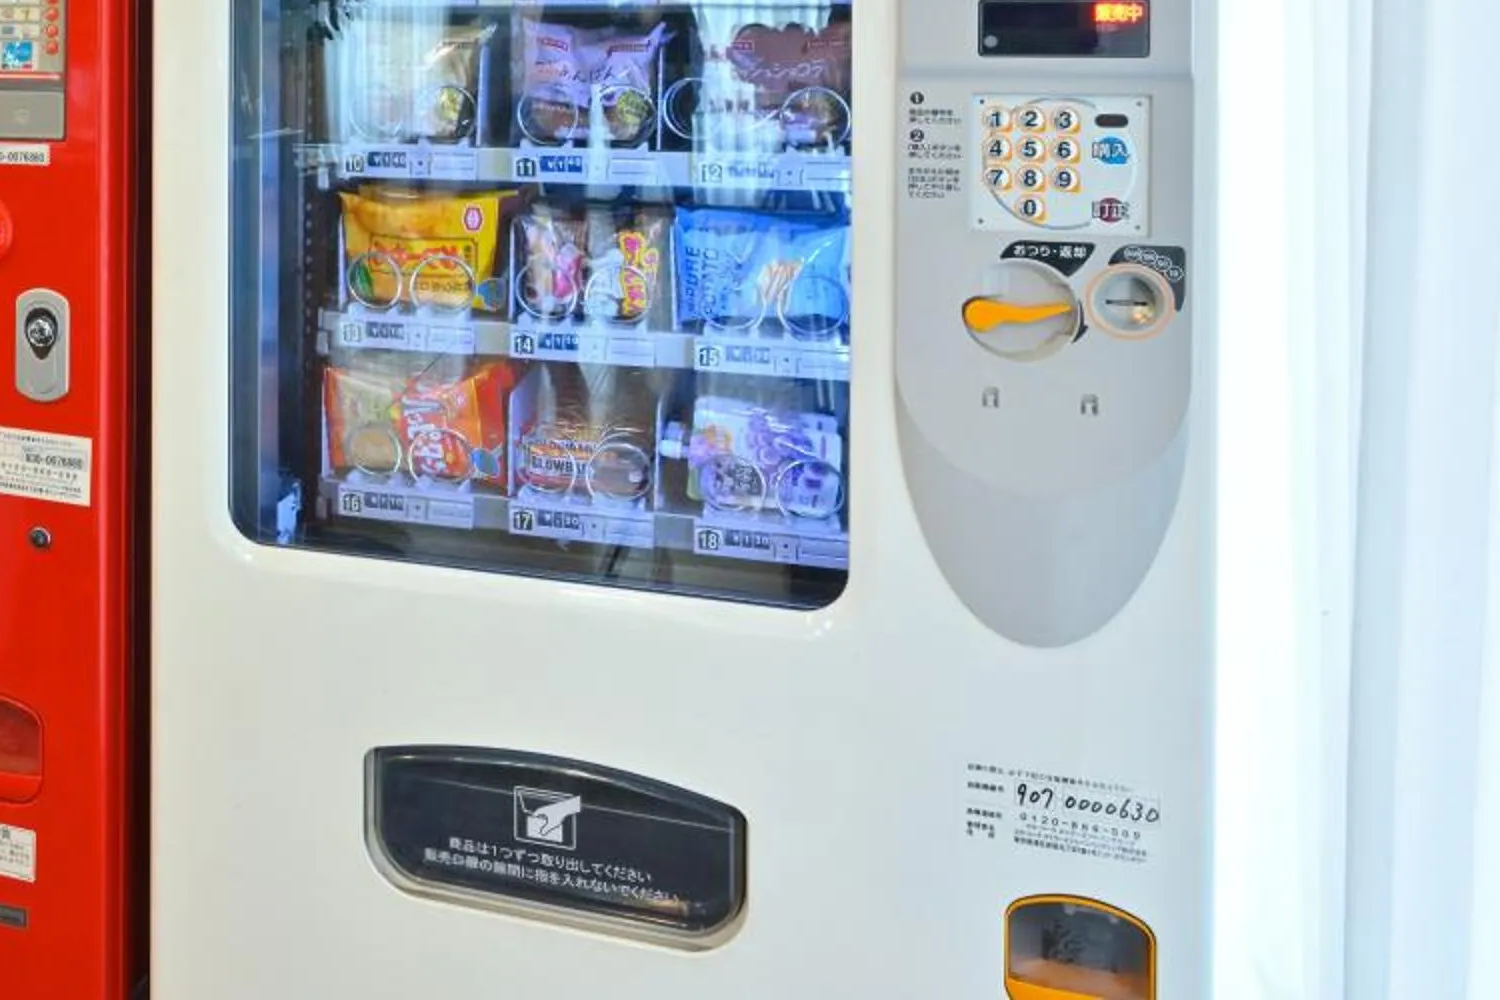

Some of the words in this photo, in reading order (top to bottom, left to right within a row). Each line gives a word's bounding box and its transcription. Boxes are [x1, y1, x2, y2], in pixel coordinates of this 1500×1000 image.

[991, 112, 1001, 127] 1
[1024, 112, 1038, 127] 2
[1059, 112, 1071, 128] 3
[990, 141, 1002, 156] 4
[1024, 141, 1037, 156] 5
[1058, 141, 1071, 157] 6
[517, 160, 535, 175] 11
[990, 169, 1002, 185] 7
[1023, 170, 1037, 186] 8
[1058, 170, 1071, 187] 9
[1024, 200, 1037, 216] 0
[515, 337, 534, 353] 14
[700, 348, 720, 366] 15
[344, 496, 361, 511] 16
[514, 514, 532, 530] 17
[699, 532, 719, 549] 18
[1017, 783, 1054, 809] 907
[1064, 797, 1160, 823] 0000630
[449, 836, 653, 884] 商品は1つずつ取り出してください
